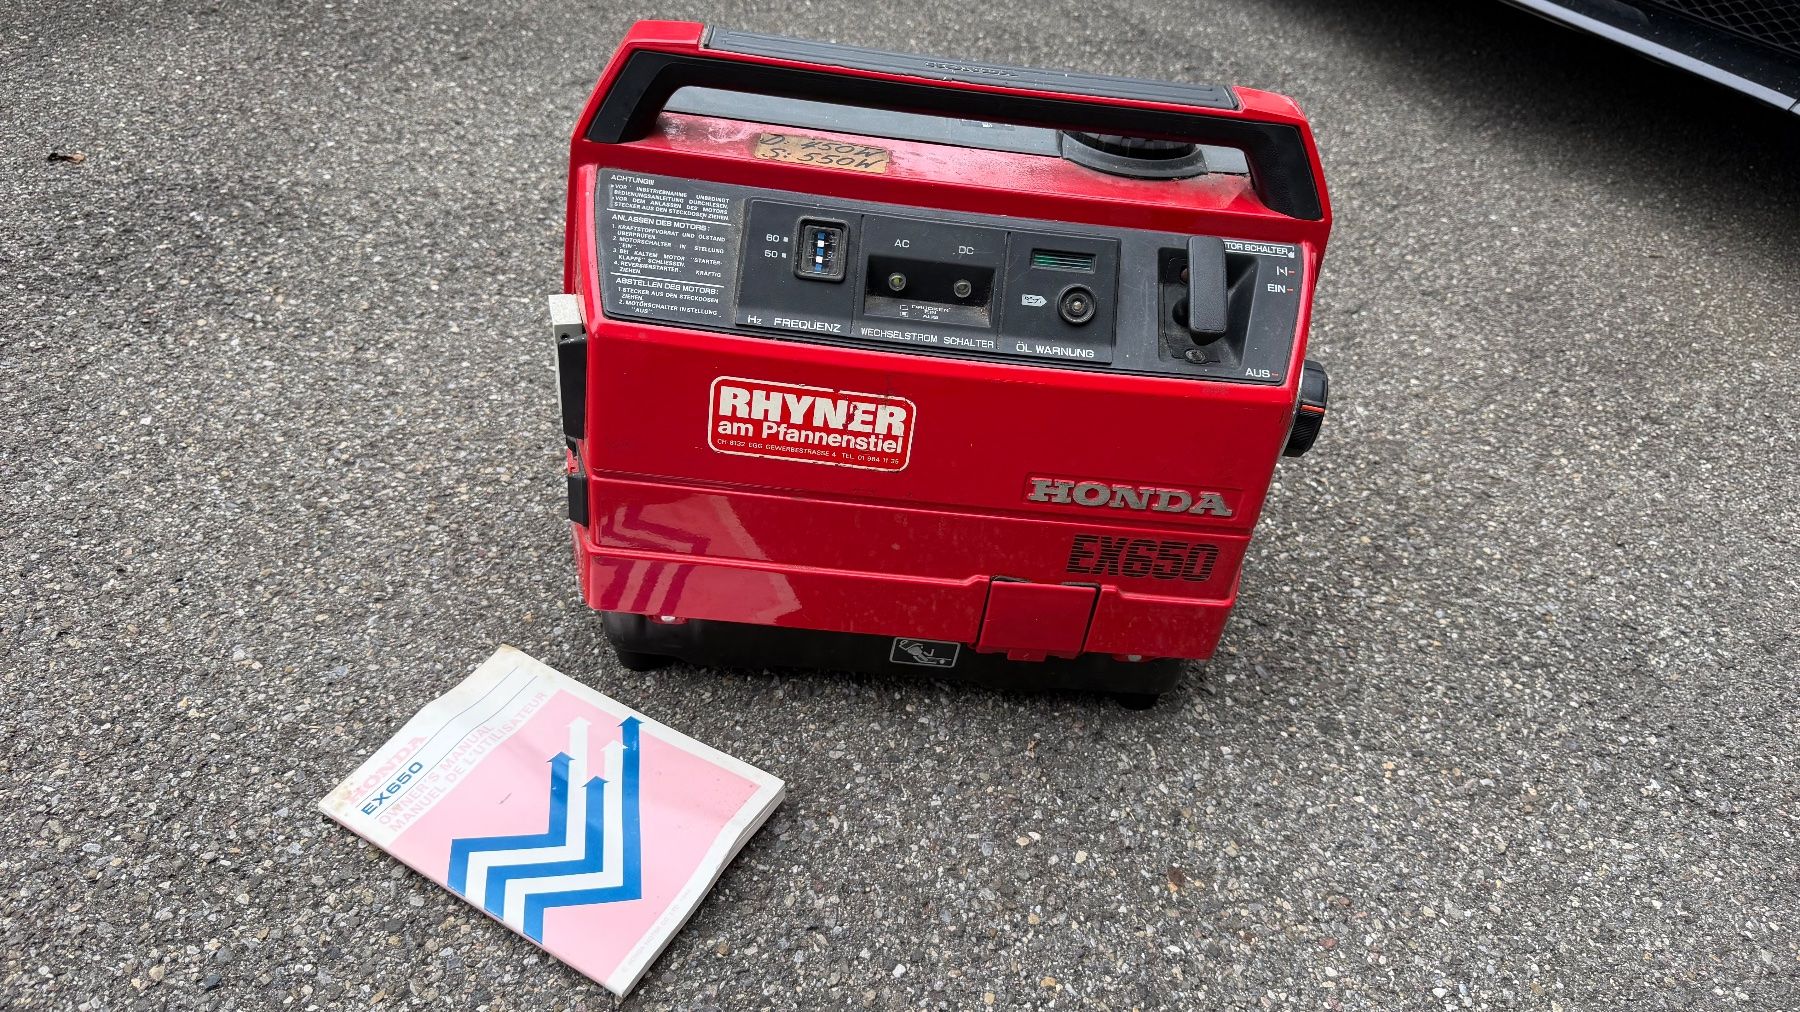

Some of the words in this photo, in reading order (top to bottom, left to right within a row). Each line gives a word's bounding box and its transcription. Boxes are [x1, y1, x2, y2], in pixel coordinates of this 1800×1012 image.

[797, 153, 884, 168] 550W
[614, 189, 684, 204] BEDIENUNGSANLEITUNG
[696, 194, 730, 204] UNBEDINGT
[614, 202, 640, 210] STECKER
[669, 208, 707, 218] STECKDOSEN
[650, 200, 681, 209] ANLASSEN
[703, 207, 728, 215] MOTORS
[612, 214, 654, 225] ANLASSEN
[618, 225, 679, 237] KRAFTSTOFFVORRAT
[619, 237, 672, 248] MOTORSCHALTER
[694, 246, 724, 254] STELLUNG
[894, 239, 910, 248] AC
[958, 246, 974, 255] DC
[1244, 245, 1288, 254] SCHALTER
[616, 277, 662, 289] ABSTELLEN
[664, 283, 681, 291] DES
[1267, 284, 1286, 293] EIN
[625, 300, 678, 311] MOTORSCHALTER
[680, 295, 719, 304] STECKDOSEN
[747, 315, 762, 325] Hz
[774, 318, 842, 333] FREQUENZ
[861, 328, 937, 343] WECHSELSTROM
[943, 336, 994, 349] SCHALTER
[1016, 341, 1032, 353] ÖL
[1036, 345, 1094, 358] WARNUNG
[1245, 368, 1270, 378] AUS
[718, 385, 907, 436] RHYNER
[717, 420, 754, 437] am
[761, 421, 903, 454] Pfannenstiel
[765, 445, 829, 457] GEWERBESTRASSE
[1027, 477, 1233, 517] HONDA
[1066, 534, 1219, 582] EX650
[389, 785, 449, 833] MANUEL
[446, 766, 464, 782] DE
[466, 691, 549, 767] L'UTILISATEUR
[344, 736, 428, 804] HONDA
[379, 774, 440, 825] OWNER'S
[440, 725, 497, 772] MANUAL
[361, 761, 424, 815] EX650
